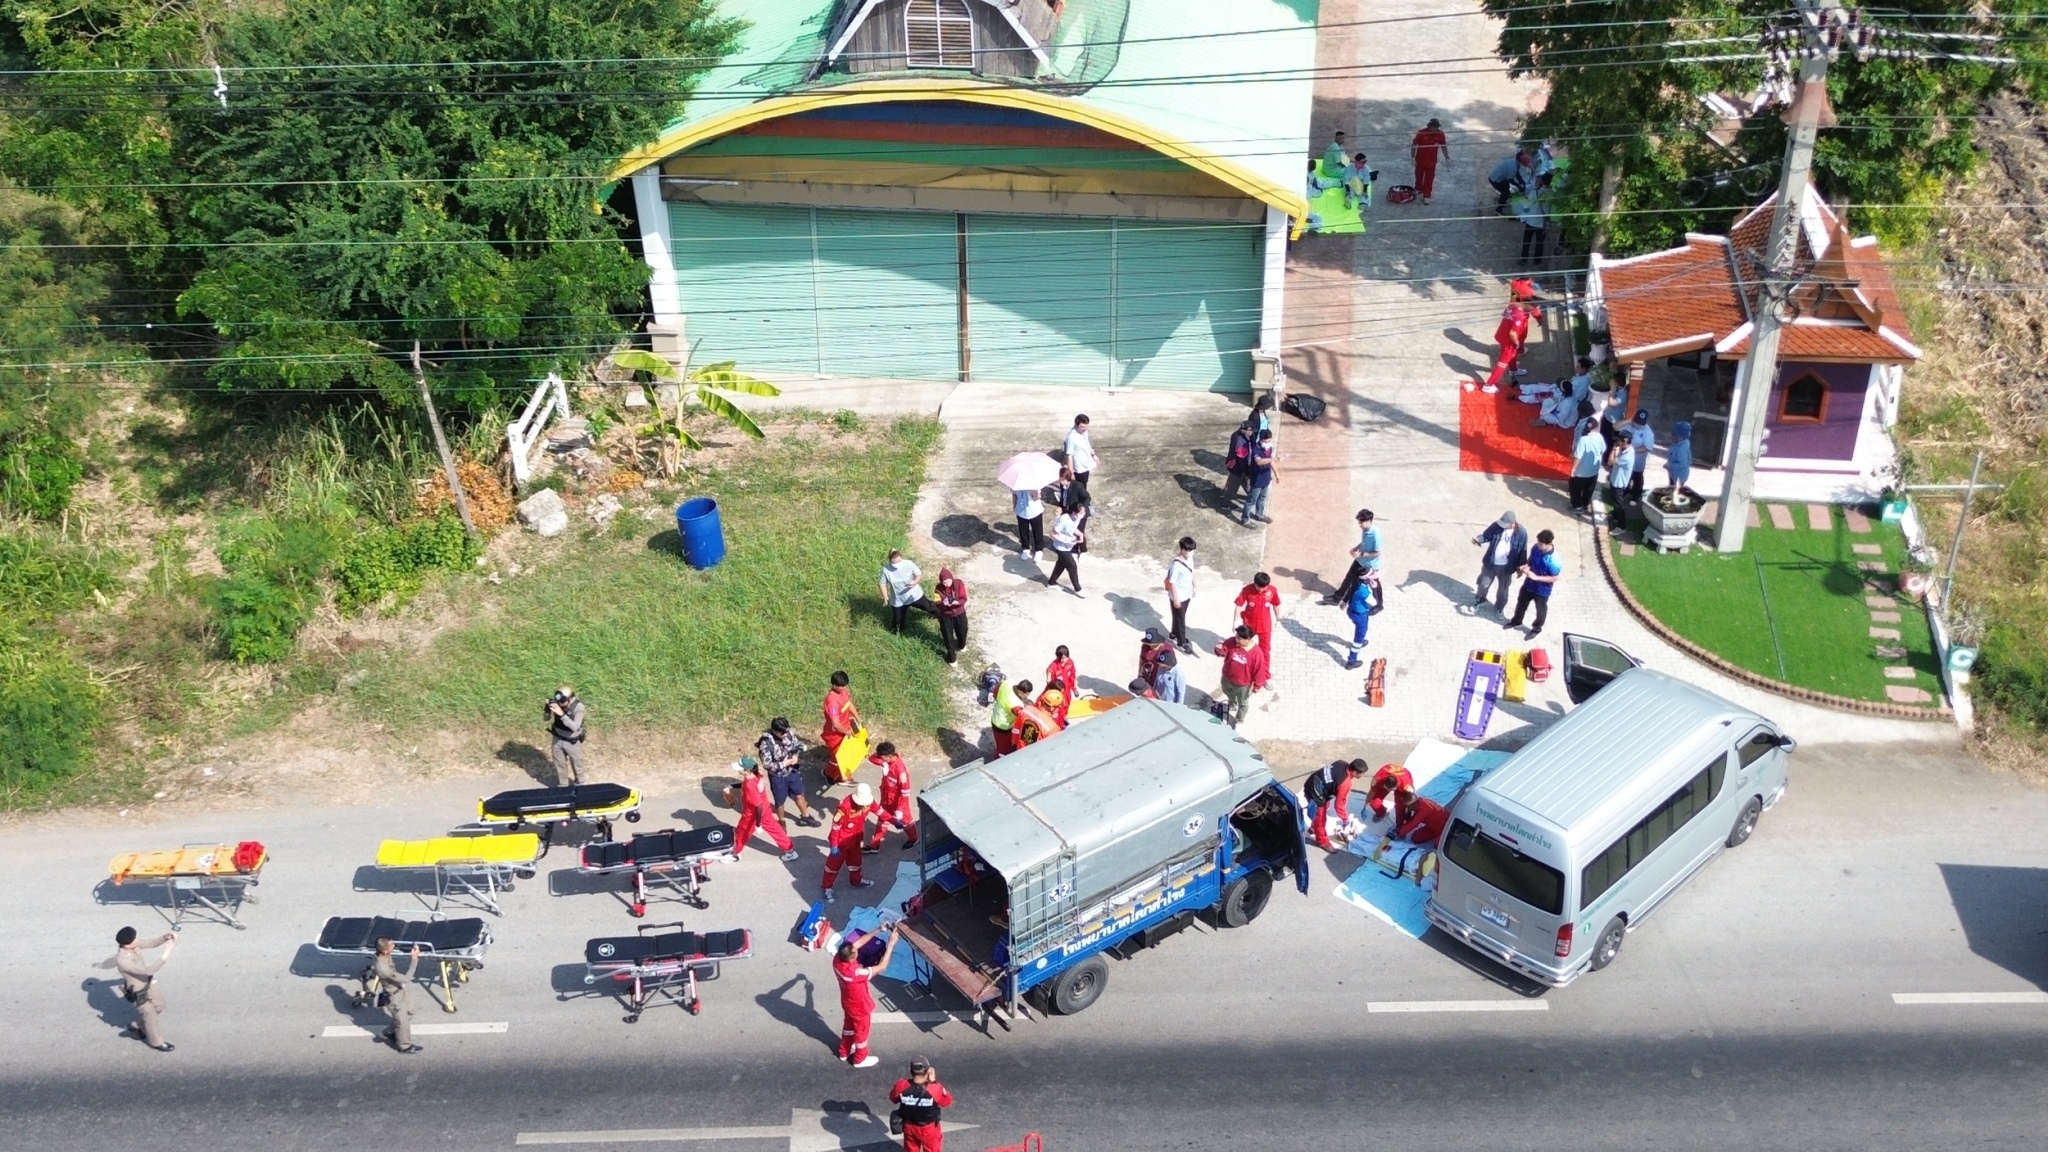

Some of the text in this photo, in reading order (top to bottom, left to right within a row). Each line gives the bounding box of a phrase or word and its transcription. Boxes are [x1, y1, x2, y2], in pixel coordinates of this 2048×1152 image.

[1951, 649, 1974, 667] C
[1062, 887, 1186, 957] โรงพยาบาลโคกสำโรง
